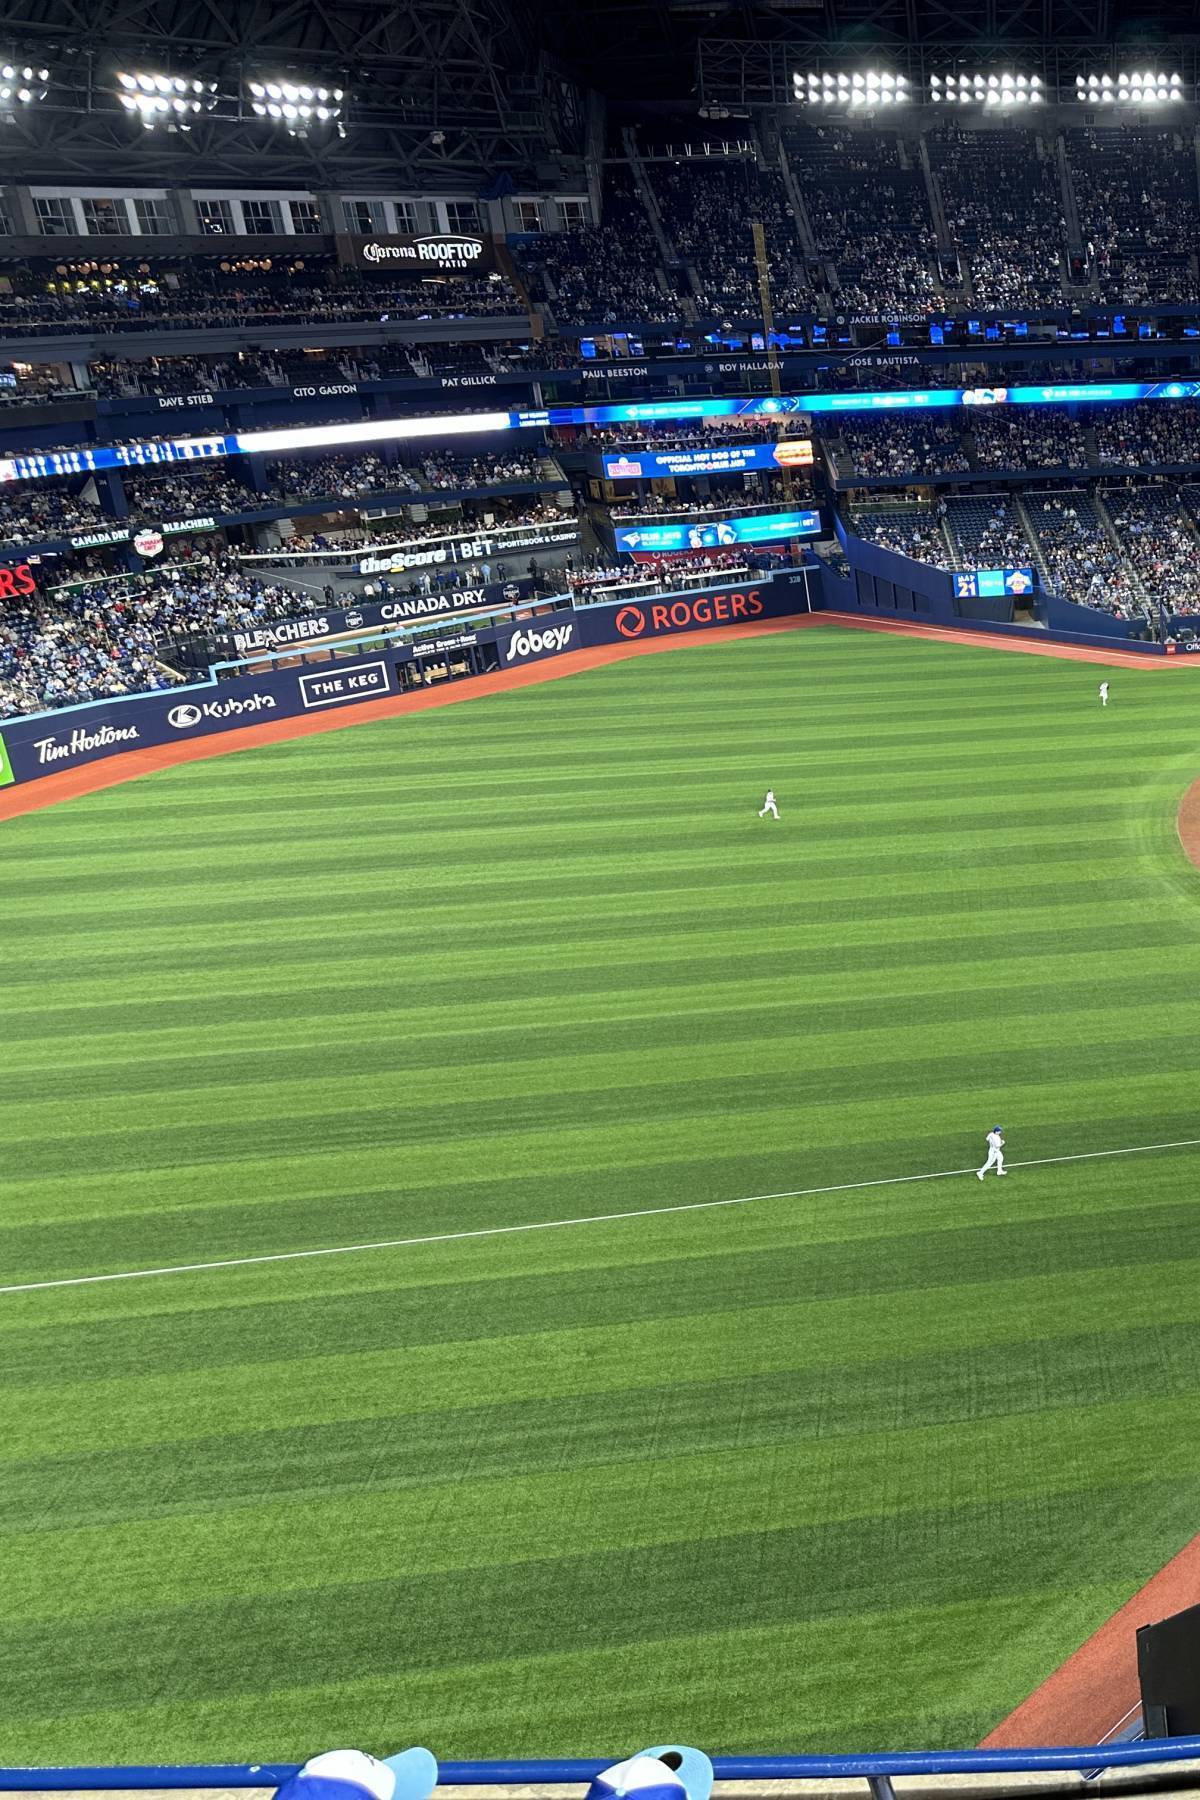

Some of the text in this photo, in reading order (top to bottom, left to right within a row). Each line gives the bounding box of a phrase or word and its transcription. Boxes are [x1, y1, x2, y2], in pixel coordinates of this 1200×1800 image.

[363, 241, 483, 263] Corona ROOFTOP
[438, 260, 468, 268] PATIO
[850, 314, 926, 324] JACKIE ROBINSON
[719, 362, 737, 372] ROY
[740, 361, 785, 371] HALLADAY
[849, 356, 920, 366] JOSÉ BAUTISTA
[582, 368, 648, 379] PAUL BEESTON
[441, 376, 496, 388] PAT GILLICK
[293, 384, 358, 397] CITO GASTON
[158, 394, 214, 408] DAVE STIEB
[656, 455, 692, 465] OFFICIAL
[742, 449, 756, 457] THE
[669, 464, 706, 472] TORONTO
[162, 518, 215, 532] BLEACHERS
[70, 529, 130, 547] CANADA DRY
[359, 532, 577, 575] theScore BET SPORTSBOOK & CASINO
[958, 574, 976, 582] MAY
[958, 582, 976, 597] 21
[380, 596, 450, 620] CANADA
[652, 590, 763, 631] ROGERS
[506, 624, 573, 661] Sobeys
[312, 672, 379, 696] THE KEG
[204, 693, 277, 719] Kubota
[34, 736, 70, 765] Tim
